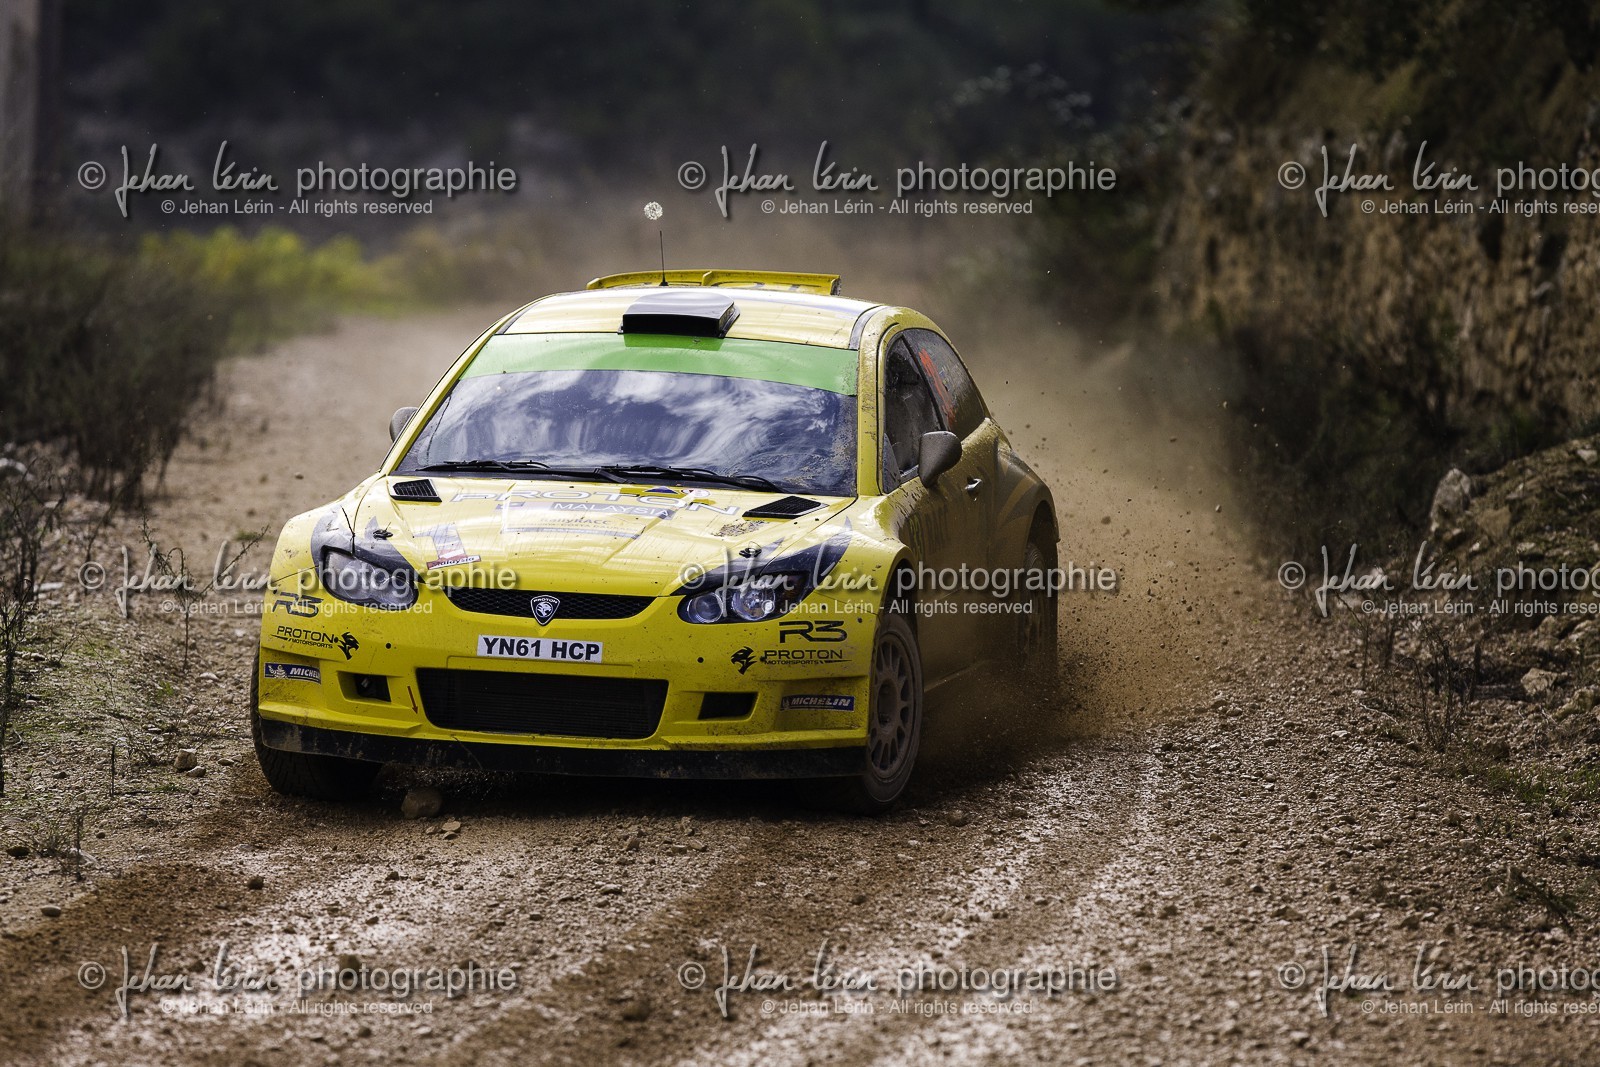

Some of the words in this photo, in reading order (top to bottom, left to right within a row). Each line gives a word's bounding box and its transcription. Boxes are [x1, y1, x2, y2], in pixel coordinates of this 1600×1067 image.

[452, 489, 741, 516] PROTON
[554, 502, 670, 518] MALAYSIA
[276, 625, 335, 644] PROTON
[778, 620, 848, 644] R3
[291, 638, 334, 649] MOTORSPORTS
[483, 636, 541, 657] YN61
[550, 641, 600, 661] HCP
[763, 649, 843, 660] PROTON
[790, 696, 851, 707] MICHELIN
